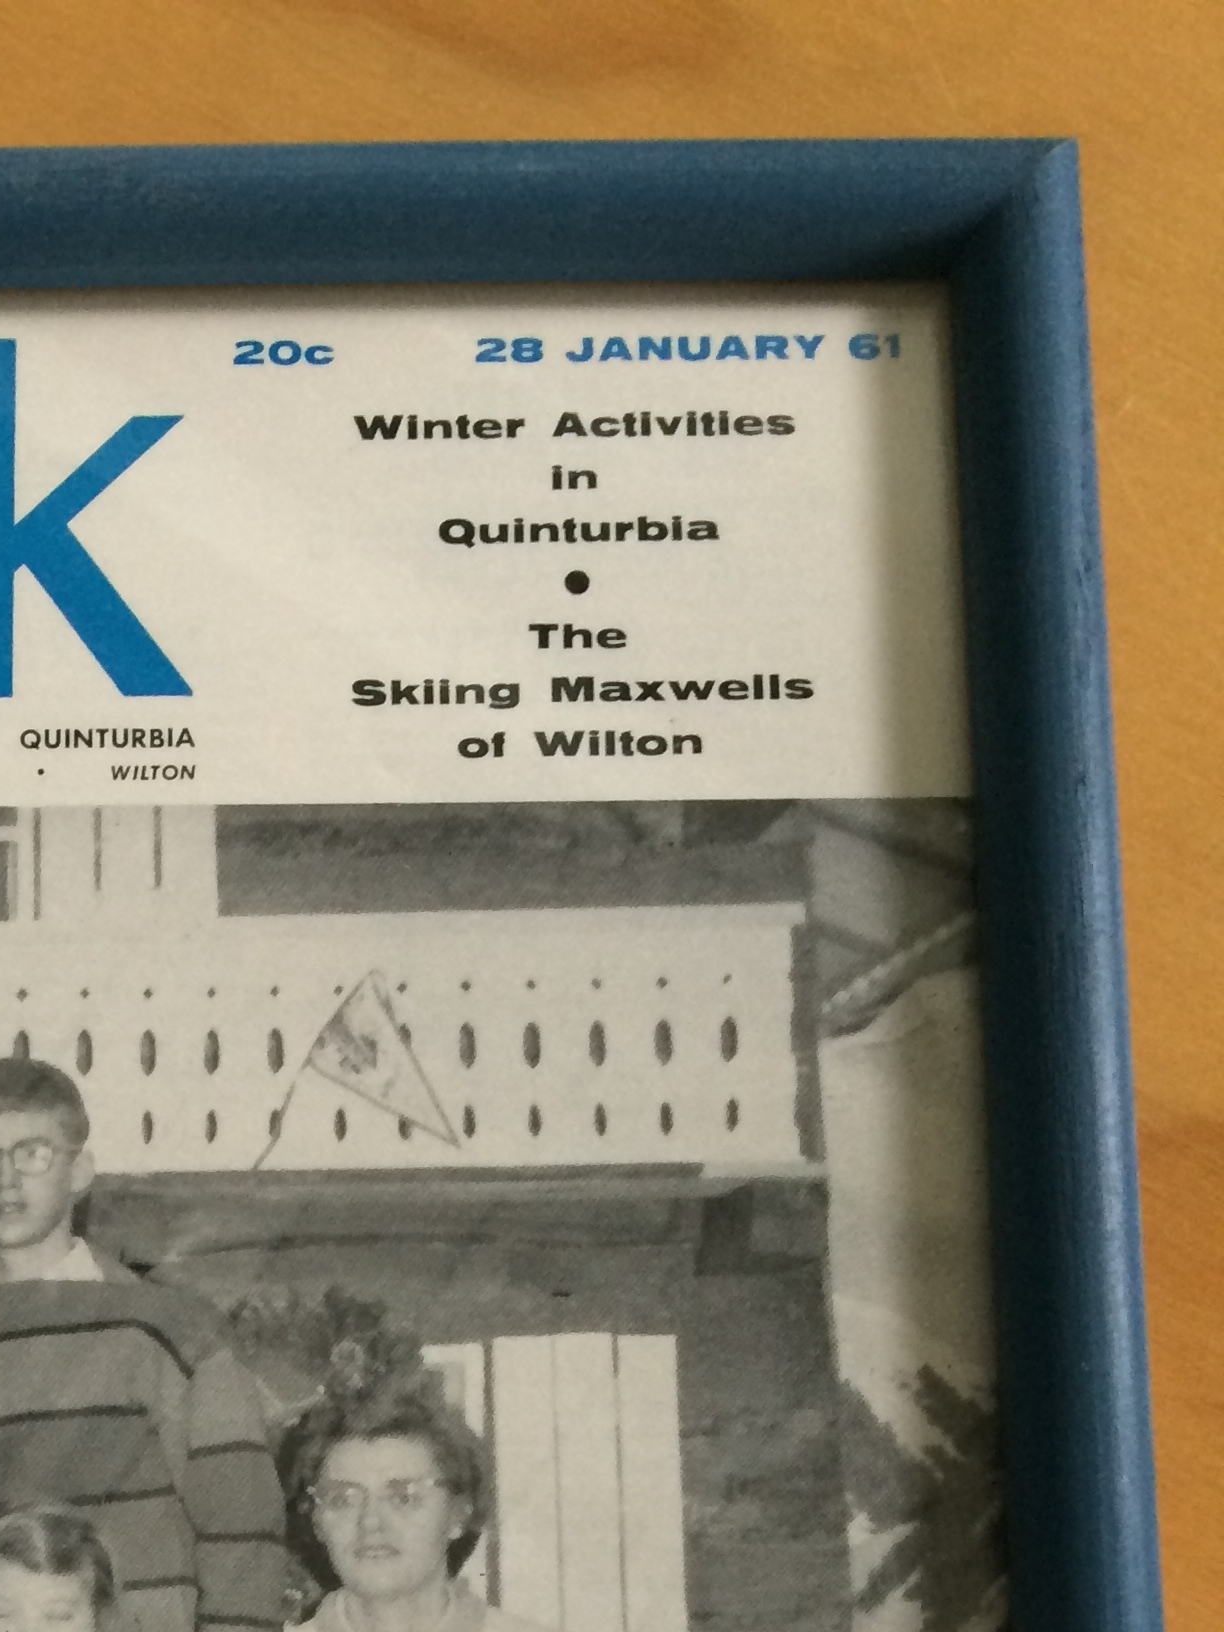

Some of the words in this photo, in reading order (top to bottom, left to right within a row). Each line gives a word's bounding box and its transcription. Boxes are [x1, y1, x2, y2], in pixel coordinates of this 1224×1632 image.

[233, 339, 334, 366] 20c
[475, 336, 544, 364] 28
[565, 334, 825, 363] JANUARY
[847, 332, 903, 362] 61
[353, 414, 525, 441] Winter
[552, 410, 796, 438] Activities
[551, 464, 597, 491] in
[438, 515, 720, 549] Quinturbia
[528, 623, 627, 650] The
[351, 678, 520, 710] Skiing
[551, 673, 815, 703] Maxwells
[20, 727, 196, 750] QUINTURBIA
[457, 731, 506, 759] of
[533, 729, 703, 757] Wilton
[111, 764, 196, 781] WILTON
